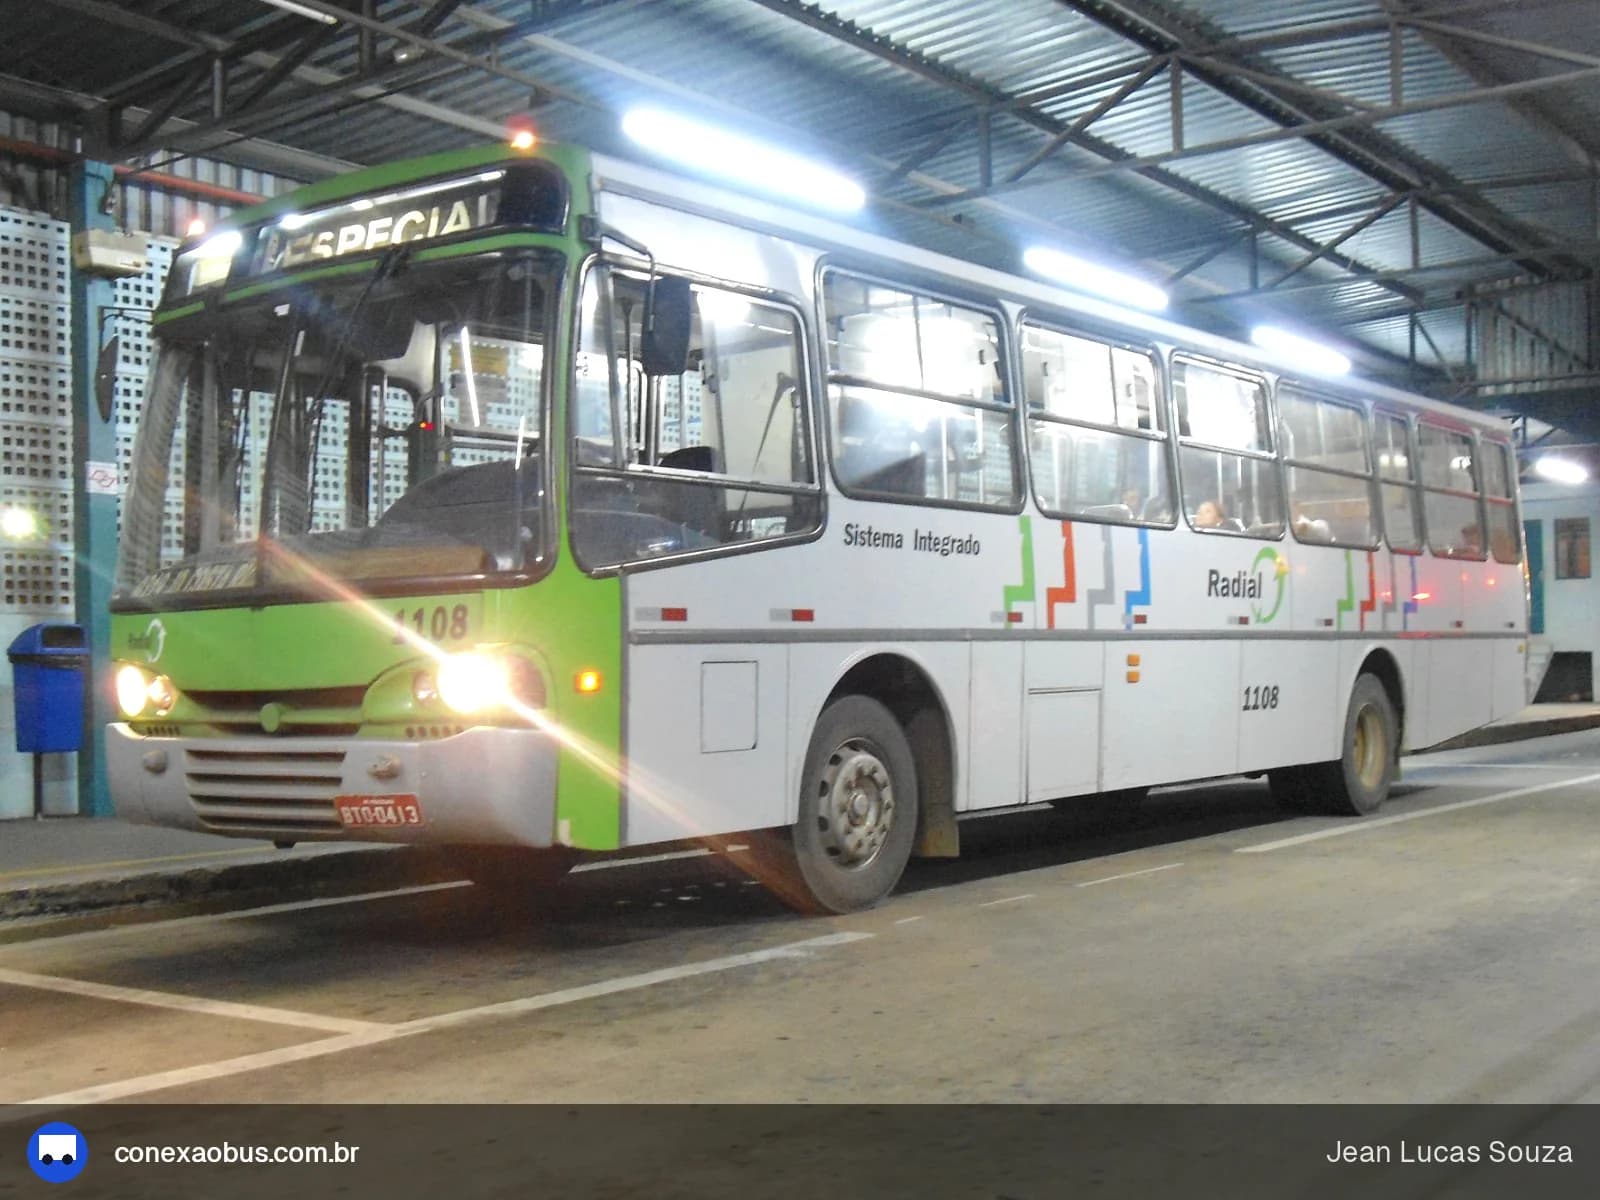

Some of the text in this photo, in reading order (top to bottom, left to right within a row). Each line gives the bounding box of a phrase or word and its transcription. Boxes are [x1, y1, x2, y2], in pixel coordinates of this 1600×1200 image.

[843, 522, 981, 557] Sistema Integrado
[1207, 568, 1263, 600] Radial
[391, 603, 469, 646] 1108
[1242, 685, 1280, 712] 1108
